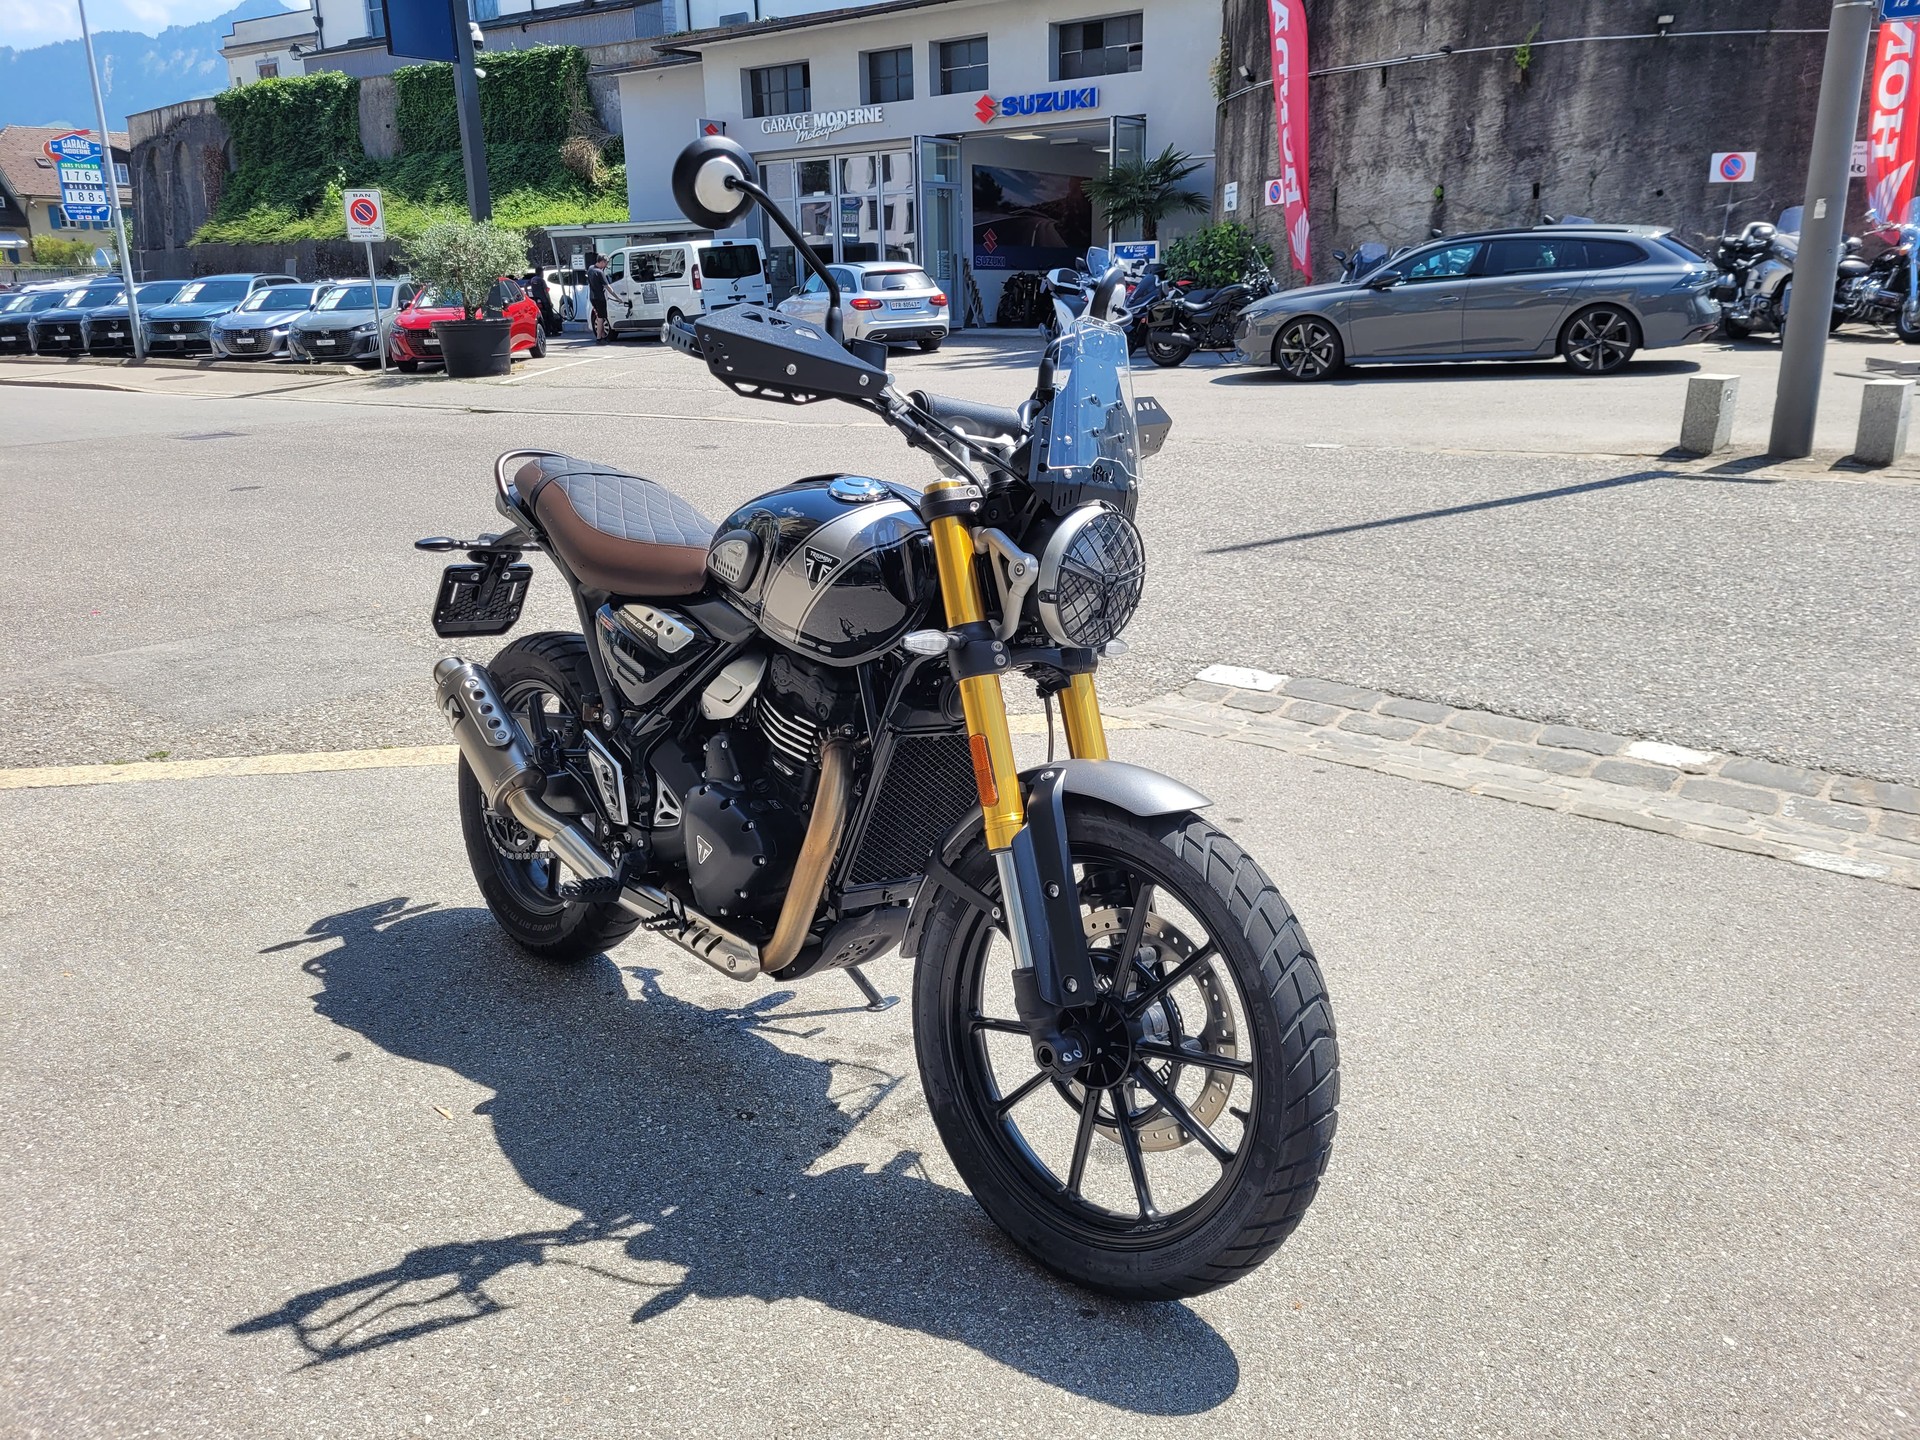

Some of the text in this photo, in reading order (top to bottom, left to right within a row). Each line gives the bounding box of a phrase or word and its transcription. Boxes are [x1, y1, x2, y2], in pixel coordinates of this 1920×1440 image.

[1001, 87, 1097, 116] SUZUKI
[761, 107, 884, 134] GARAGE MODERNE
[795, 121, 848, 144] Motocycles
[62, 139, 90, 150] GARAGE
[975, 255, 1006, 267] SUZUKI
[810, 550, 833, 564] TRIUMPH
[618, 609, 644, 630] SCRAMBLER
